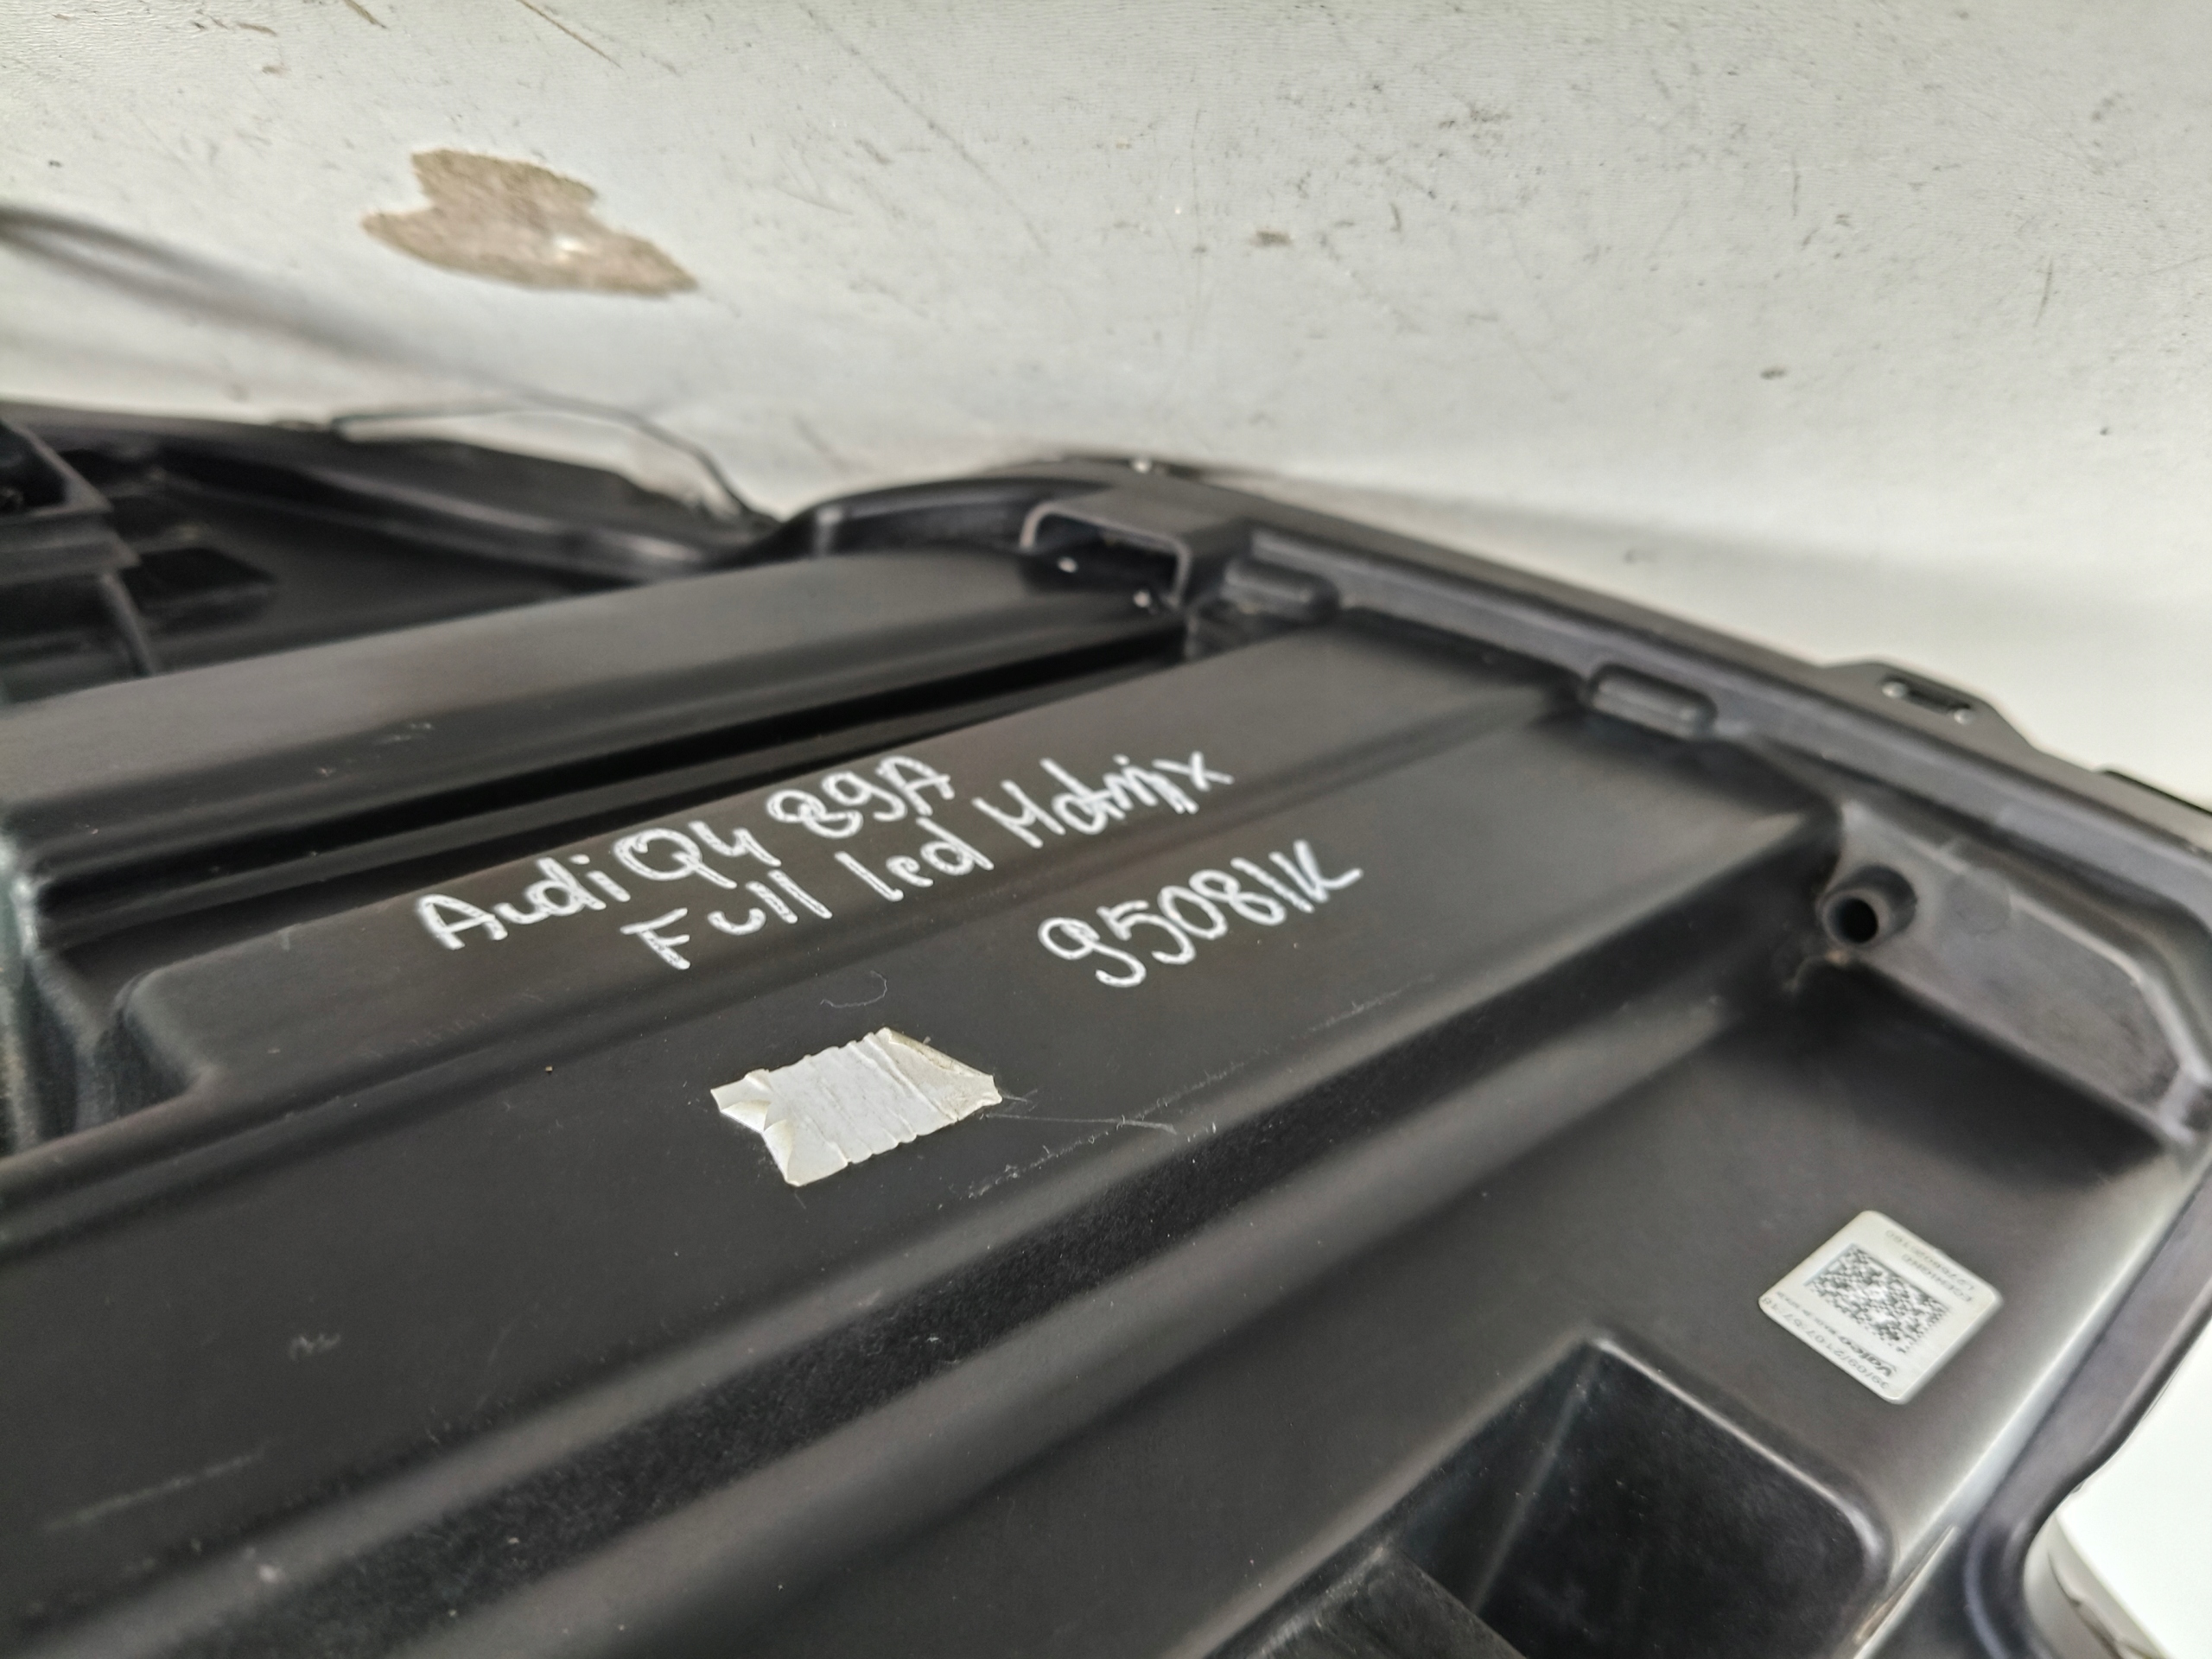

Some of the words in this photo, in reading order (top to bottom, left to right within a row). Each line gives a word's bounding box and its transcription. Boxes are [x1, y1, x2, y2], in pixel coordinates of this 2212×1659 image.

[416, 854, 632, 950] Audi
[765, 754, 955, 840] 89A
[620, 868, 833, 970] Full
[1037, 839, 1363, 988] 95081K
